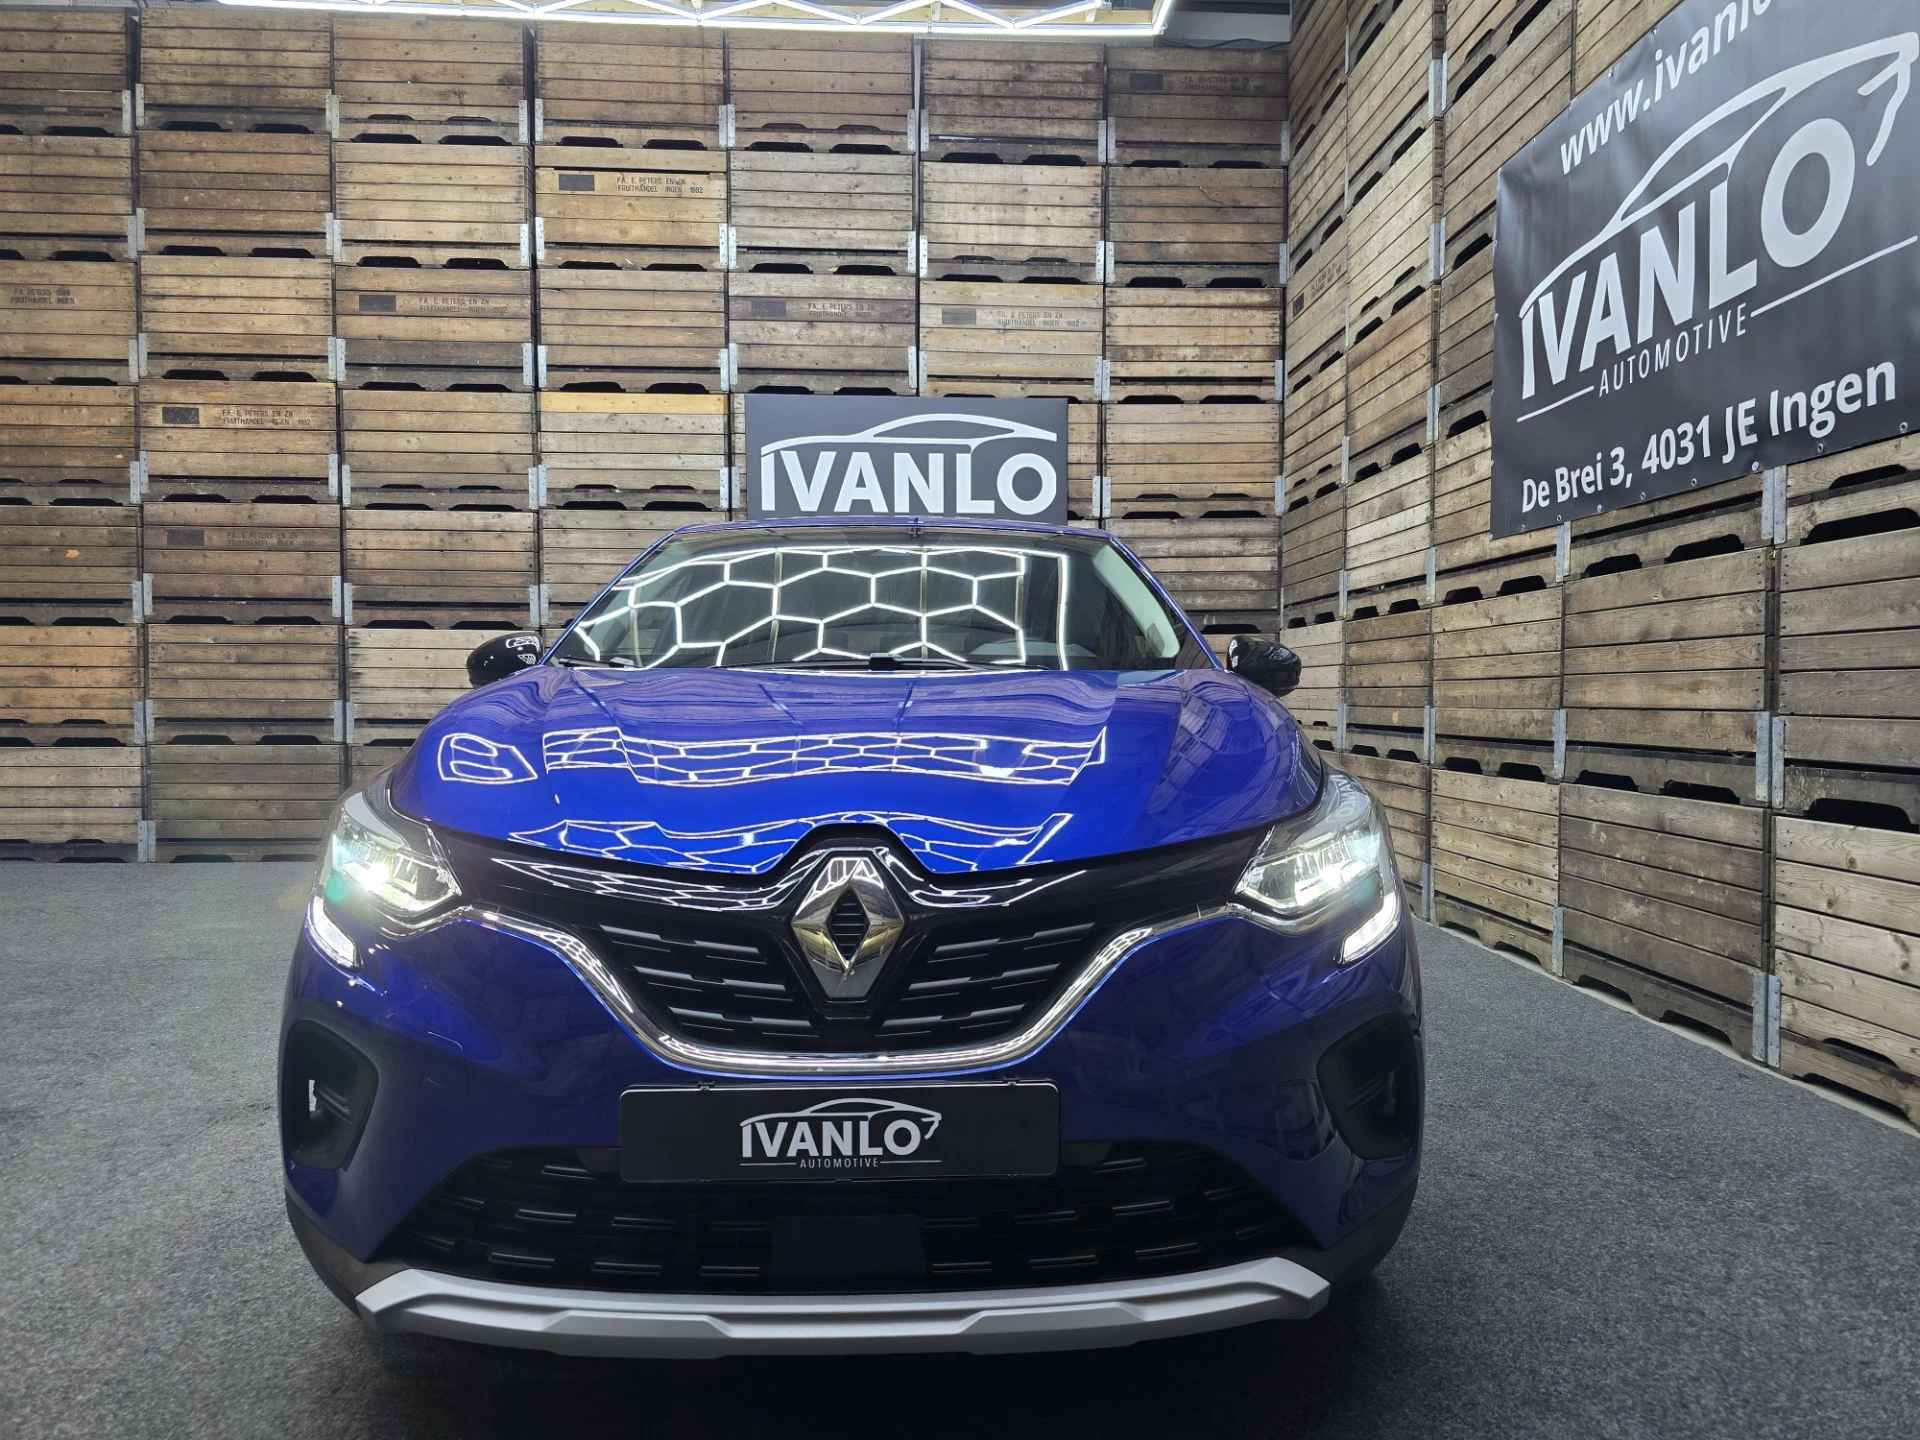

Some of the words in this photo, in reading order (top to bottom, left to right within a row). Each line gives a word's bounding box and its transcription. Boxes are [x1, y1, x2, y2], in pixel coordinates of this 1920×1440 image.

[617, 185, 658, 193] FRUITHANDEL
[639, 177, 662, 185] PETERS
[1522, 117, 1855, 400] IVANLO
[10, 296, 52, 304] FRUITHANDEL
[1018, 311, 1040, 319] PETERS
[1599, 302, 1746, 397] AUTOMOTIVE
[1522, 478, 1550, 513] De
[1555, 452, 1603, 503] Brei
[1610, 446, 1634, 488] 3,
[1641, 414, 1710, 474] 4031
[1722, 398, 1758, 463] JE
[1769, 361, 1896, 439] Ingen
[760, 450, 1057, 515] IVANLO
[742, 1119, 921, 1158] IVANLO
[800, 1158, 879, 1168] AUTOMOTIVE
